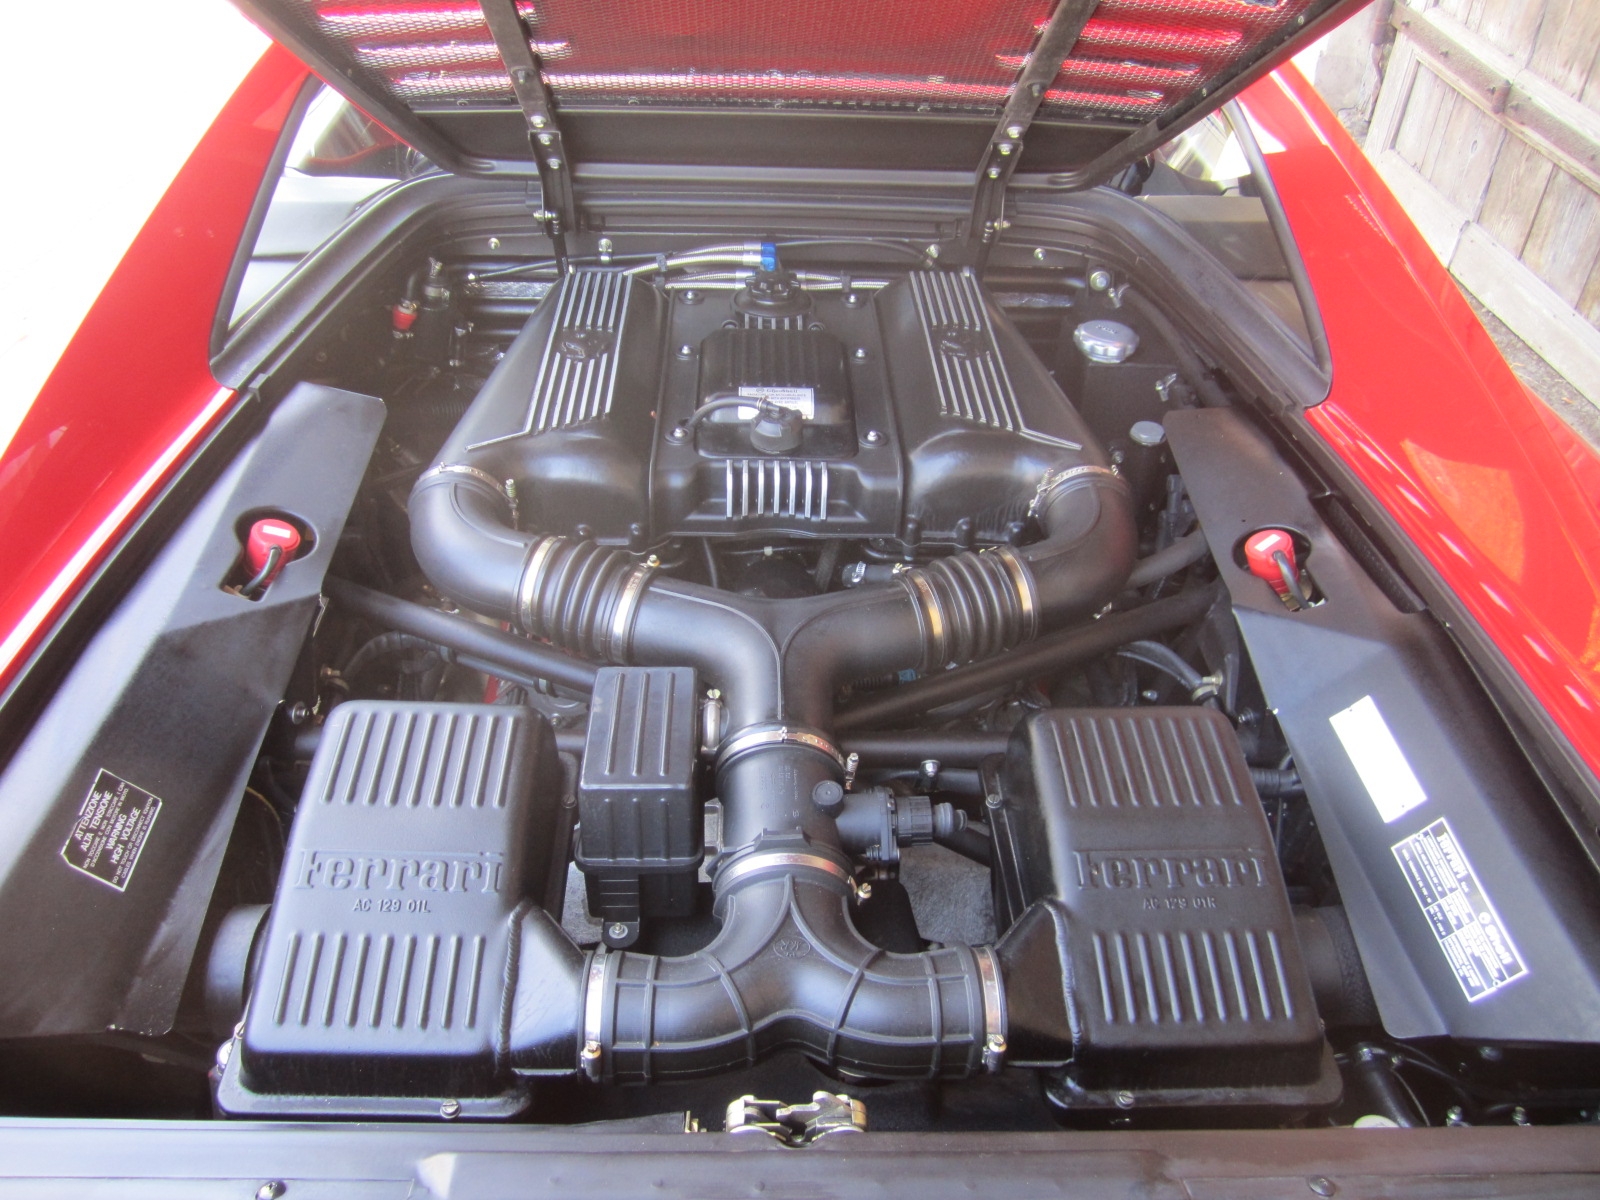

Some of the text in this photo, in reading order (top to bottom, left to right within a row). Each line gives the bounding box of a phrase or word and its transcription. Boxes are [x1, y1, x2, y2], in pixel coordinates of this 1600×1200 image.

[75, 791, 102, 840] ATTENZIONE
[80, 791, 113, 852] ALTA TENSIONE
[106, 813, 128, 851] WARNING
[111, 807, 141, 865] HIGH VOLTAGE
[294, 848, 504, 893] Ferrari
[1073, 847, 1269, 890] Ferrari
[352, 898, 372, 912] AC
[377, 898, 401, 913] 129
[1142, 896, 1160, 910] AC
[1164, 896, 1188, 910] 129
[1435, 832, 1468, 879] Ferrari
[1484, 923, 1513, 966] Shell
